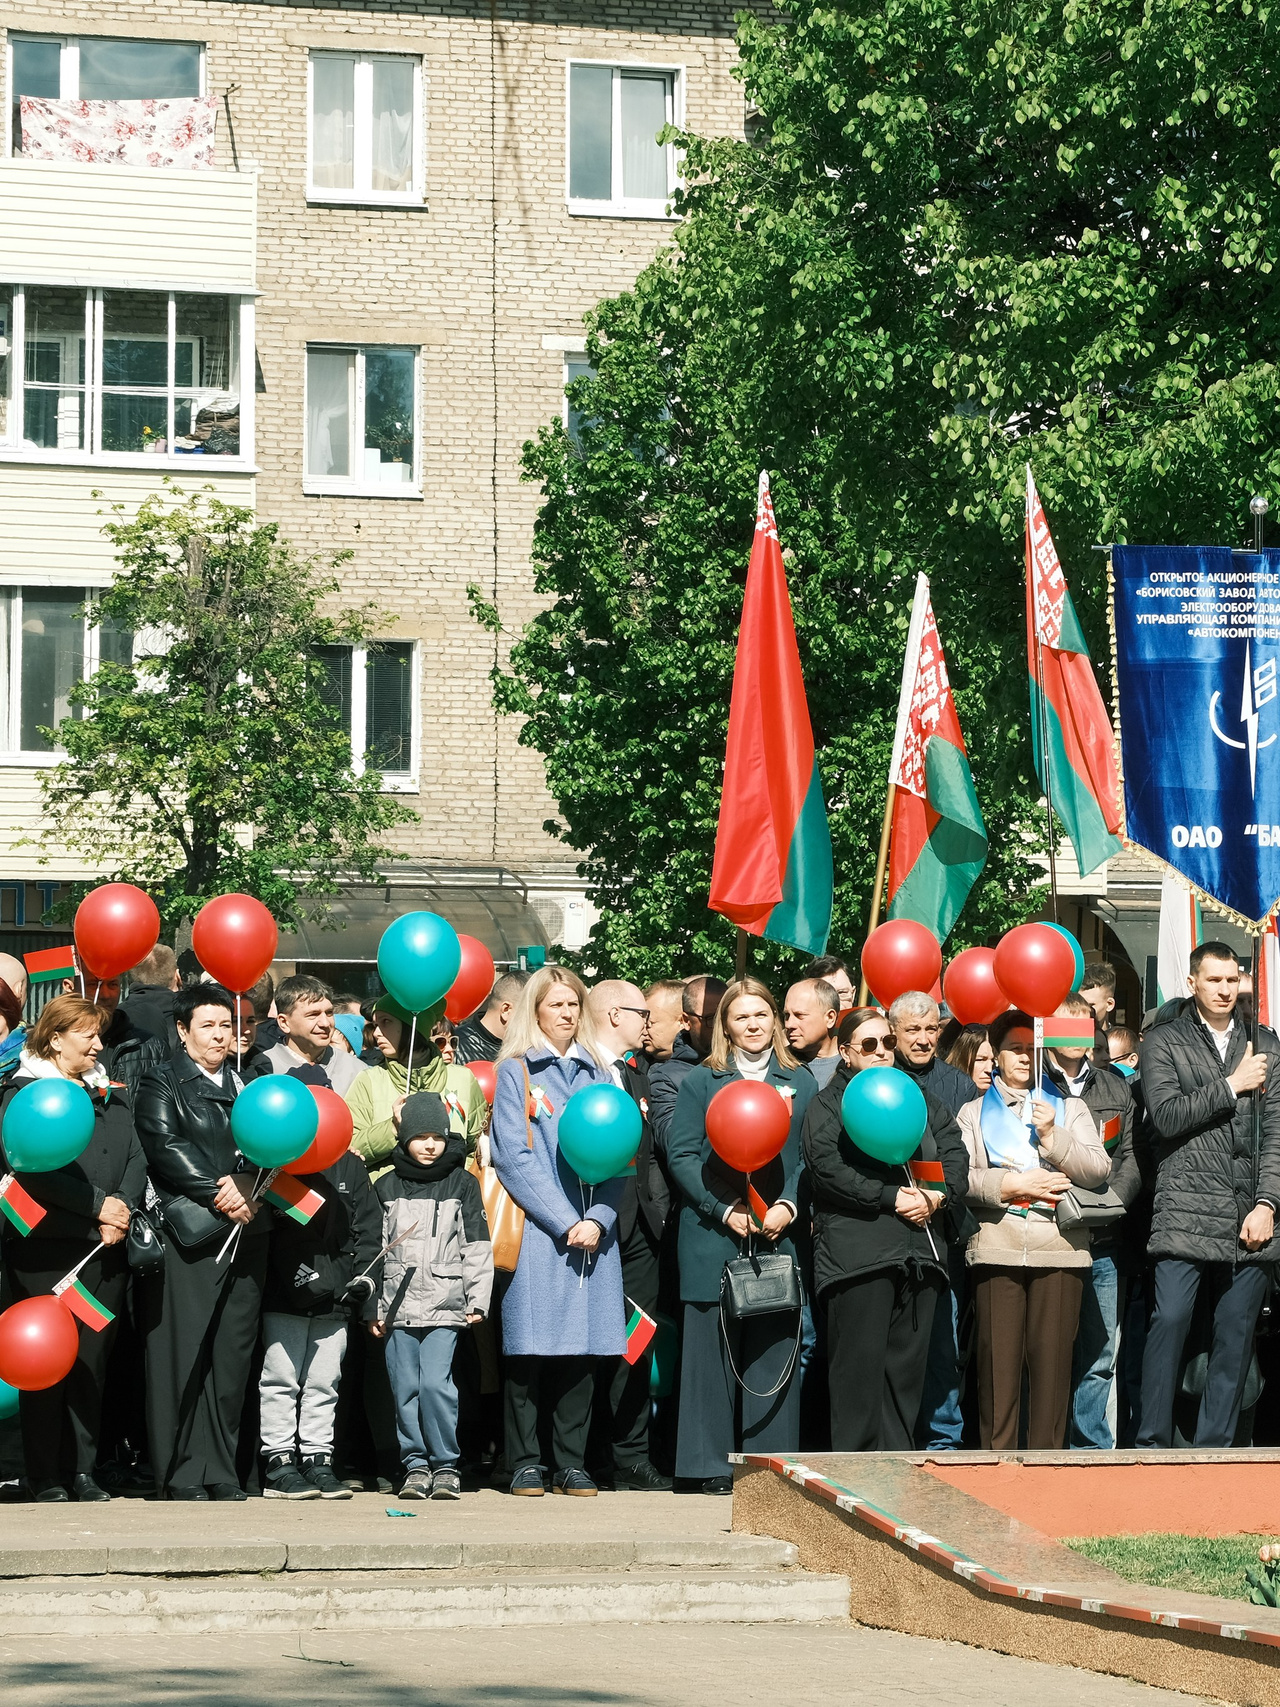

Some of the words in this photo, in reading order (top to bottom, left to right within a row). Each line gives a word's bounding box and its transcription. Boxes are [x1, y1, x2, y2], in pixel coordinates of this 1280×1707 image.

[1149, 572, 1205, 583] ОТКРЫТОЕ
[1207, 572, 1280, 585] АКЦИОНЕРНОЕ
[1136, 586, 1216, 598] «БОРИСОВСКИЙ
[1218, 587, 1256, 599] ЗАВОД
[1136, 614, 1228, 626] УПРАВЛЯЮЩАЯ
[1171, 824, 1223, 848] ОАО
